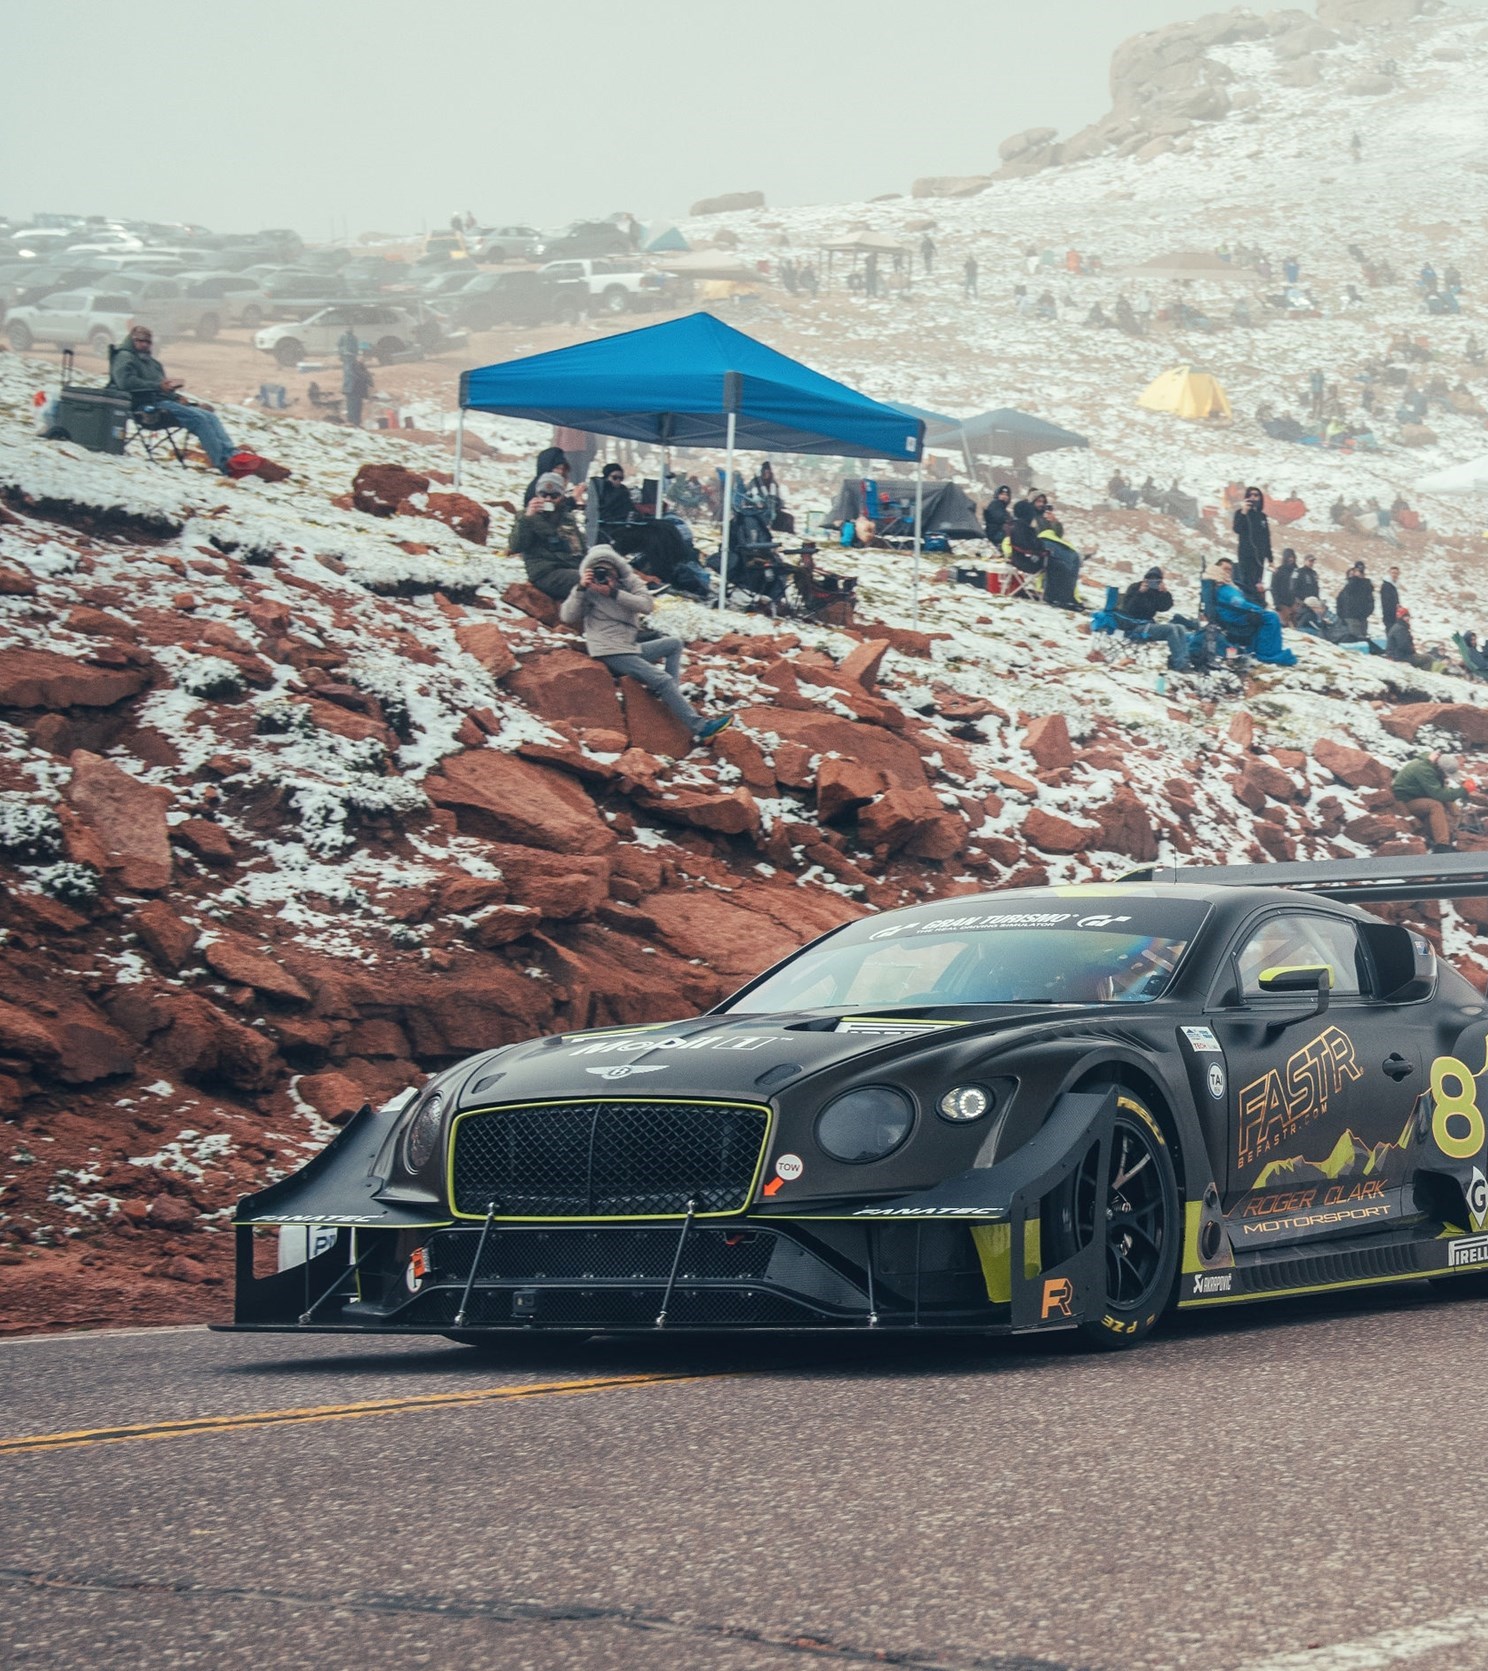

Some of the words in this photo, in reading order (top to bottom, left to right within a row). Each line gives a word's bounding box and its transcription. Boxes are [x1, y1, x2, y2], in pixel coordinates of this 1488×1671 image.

[921, 916, 981, 930] GRAN
[980, 913, 1072, 925] TURISMO
[1238, 1025, 1362, 1157] FASTR
[1430, 1056, 1486, 1159] 8
[778, 1162, 800, 1172] TOW
[852, 1207, 1004, 1216] FANATEC
[1243, 1188, 1318, 1217] ROGER
[1323, 1178, 1389, 1206] CLARK
[1471, 1179, 1486, 1213] G
[1243, 1204, 1392, 1235] MOTORSPORT
